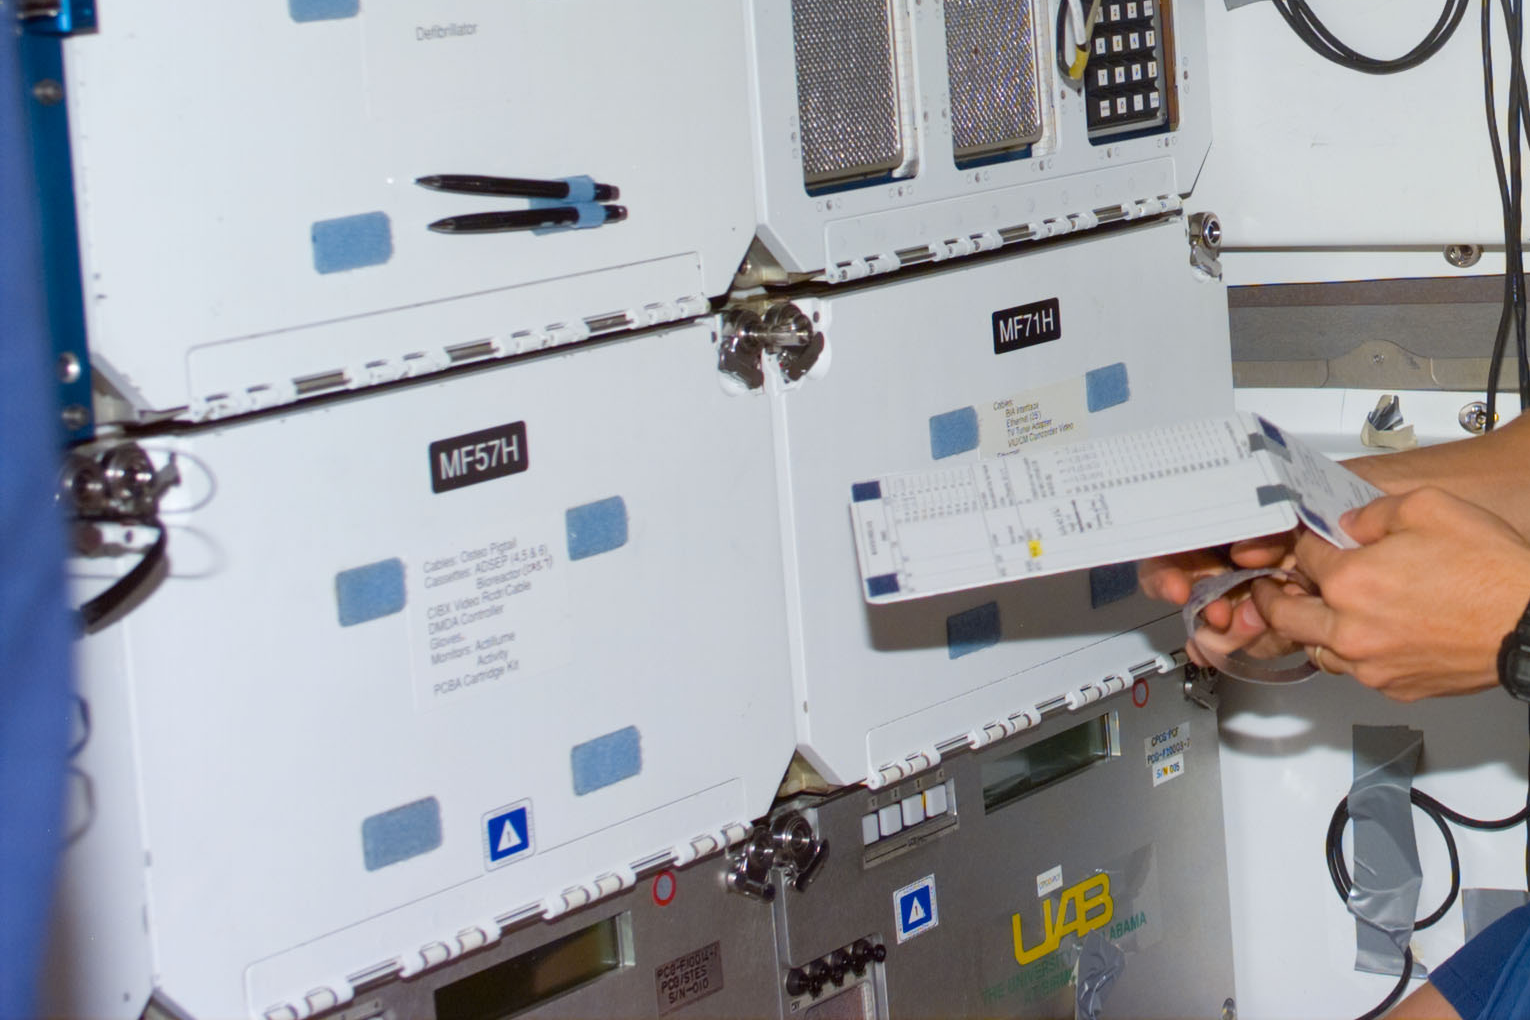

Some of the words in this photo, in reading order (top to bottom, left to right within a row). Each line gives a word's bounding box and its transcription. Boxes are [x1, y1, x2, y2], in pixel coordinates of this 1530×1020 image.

[415, 22, 479, 42] Defibrillator
[1000, 308, 1055, 344] MF71H
[1006, 414, 1029, 429] Ethernet
[1059, 420, 1075, 433] Video
[439, 434, 520, 481] MF57H
[475, 554, 508, 574] ADSEP
[476, 567, 521, 590] Bioreactor
[454, 596, 480, 612] Video
[505, 580, 531, 596] Cable
[460, 604, 504, 626] Controller
[477, 649, 509, 667] Activity
[433, 677, 461, 696] PCBA
[463, 666, 505, 687] Cartridge
[507, 658, 519, 671] Kit
[1011, 871, 1114, 966] UAB
